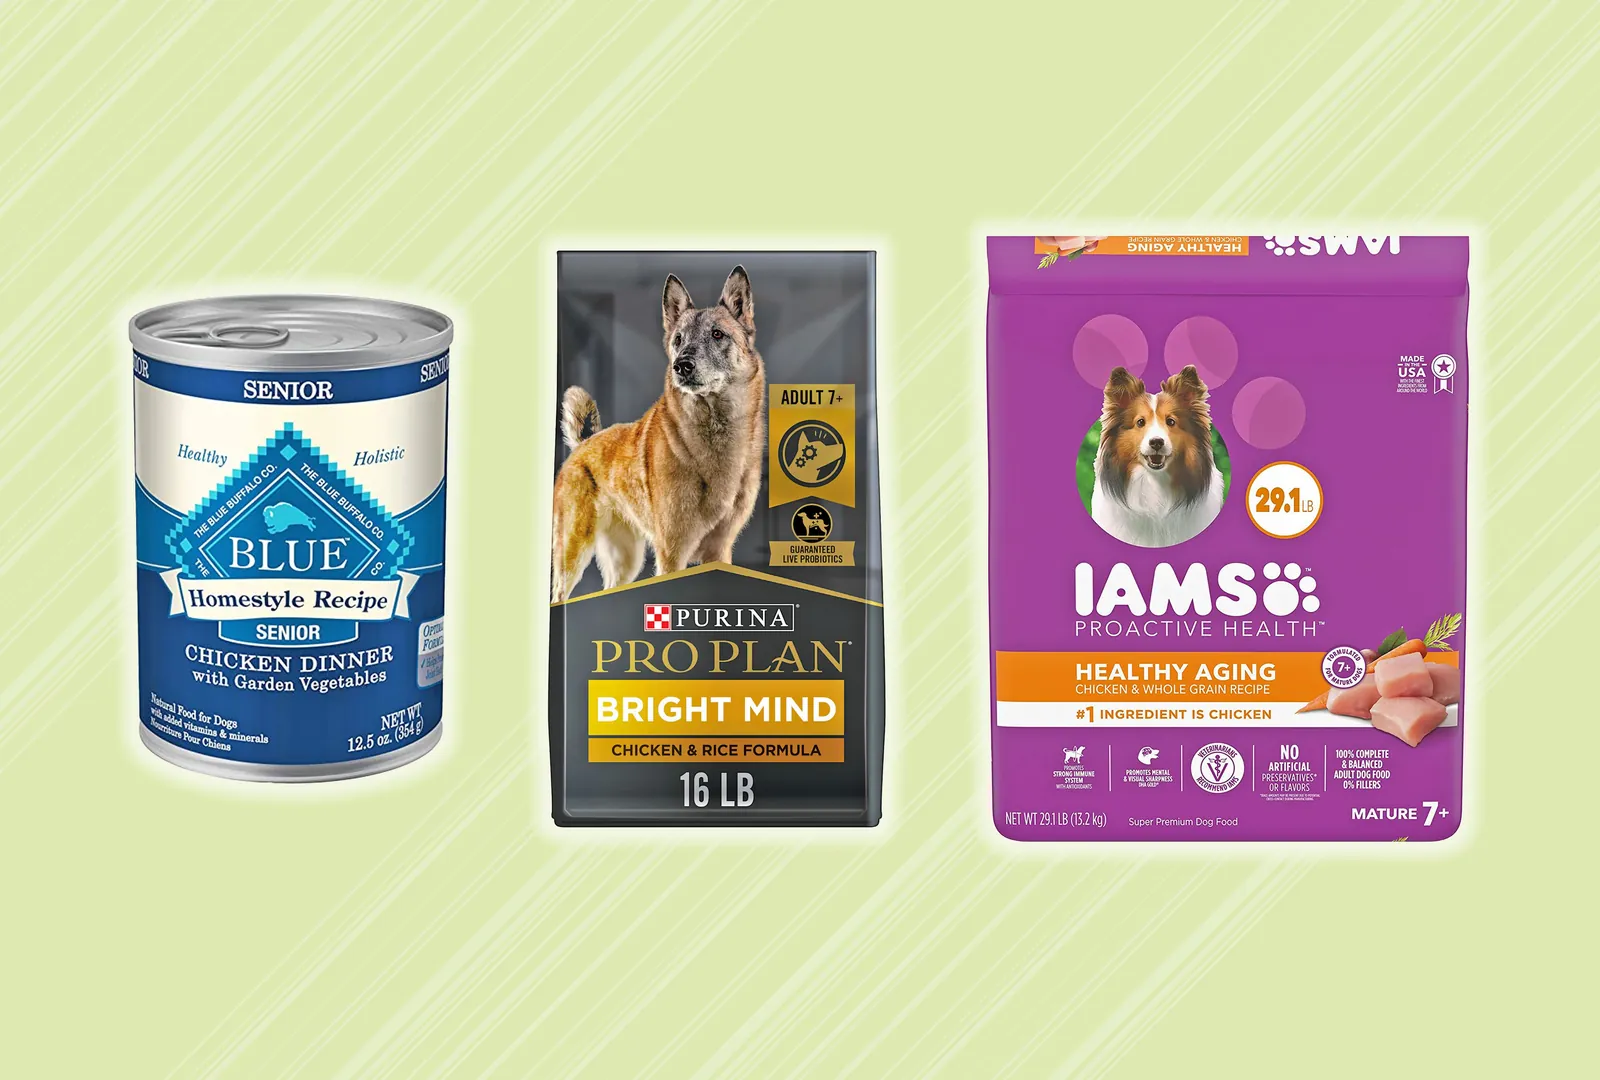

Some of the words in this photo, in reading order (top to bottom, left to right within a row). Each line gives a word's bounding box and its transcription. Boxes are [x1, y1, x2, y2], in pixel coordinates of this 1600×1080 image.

[1127, 243, 1174, 252] AGING
[1178, 243, 1241, 252] HEALTHY
[1299, 236, 1400, 256] IAMS
[421, 354, 449, 383] SENIO
[1398, 367, 1426, 377] USA
[243, 379, 334, 400] SENIOR
[781, 389, 824, 405] ADULT
[828, 389, 843, 405] 7+
[177, 444, 228, 467] Healthy
[353, 446, 405, 467] Holistic
[193, 522, 210, 538] THE
[207, 506, 229, 527] BLUE
[226, 476, 262, 509] BUFFALO
[261, 464, 278, 478] CO.
[300, 463, 319, 481] THE
[316, 478, 340, 500] BLUE
[337, 497, 373, 529] BUFFALO
[371, 527, 384, 541] CO.
[1255, 487, 1300, 514] 29.1
[1302, 500, 1313, 513] LB
[229, 536, 348, 571] BLUE
[790, 545, 836, 554] GUARANTEED
[194, 558, 211, 577] THE
[783, 555, 798, 563] LIVE
[800, 555, 843, 563] PROBIOTICS
[370, 561, 386, 576] CO.
[1075, 562, 1257, 616] IAMS
[188, 589, 305, 612] Homestyle
[313, 590, 388, 613] Recipe
[675, 608, 789, 627] PURINA
[255, 623, 320, 641] SENIOR
[1075, 621, 1212, 636] PROACTIVE
[1224, 621, 1316, 636] HEALTH
[185, 644, 290, 673] CHICKEN
[300, 645, 394, 673] DINNER
[591, 639, 699, 673] PRO
[708, 640, 847, 673] PLAN
[1327, 649, 1361, 661] FORMULATED
[1076, 663, 1187, 681] HEALTHY
[1195, 663, 1276, 681] AGING
[1337, 662, 1351, 672] 7+
[192, 669, 229, 687] with
[234, 675, 295, 692] Garden
[300, 670, 387, 694] Vegetables
[1075, 684, 1128, 695] CHICKEN
[1131, 684, 1140, 695] &
[1142, 684, 1187, 695] WHOLE
[1189, 684, 1228, 695] GRAIN
[1230, 684, 1271, 695] RECIPE
[1331, 676, 1353, 685] MATURE
[150, 692, 176, 714] Natural
[177, 705, 197, 720] Food
[198, 711, 212, 724] for
[213, 714, 238, 730] Dogs
[381, 709, 405, 730] NET
[407, 702, 422, 721] WT
[597, 696, 732, 722] BRIGHT
[744, 696, 837, 722] MIND
[1075, 706, 1095, 723] #1
[1100, 709, 1188, 720] INGREDIENT
[1191, 709, 1204, 720] IS
[1207, 709, 1272, 720] CHICKEN
[150, 707, 163, 720] with
[163, 713, 183, 728] added
[183, 721, 218, 737] vitamins
[219, 729, 228, 739] &
[229, 732, 269, 744] minerals
[150, 716, 183, 739] Nourriture
[183, 731, 201, 745] Pour
[202, 737, 232, 752] Chiens
[347, 734, 374, 752] 12.5
[377, 734, 393, 746] oz.
[394, 721, 414, 743] (354
[416, 716, 424, 736] g)
[611, 744, 682, 757] CHICKEN
[687, 744, 697, 757] &
[703, 744, 738, 757] RICE
[743, 744, 822, 757] FORMULA
[1198, 745, 1237, 758] VETERINARIANS
[1281, 745, 1299, 760] NO
[1336, 750, 1354, 759] 100%
[1356, 750, 1389, 759] COMPLETE
[1268, 762, 1310, 771] ARTIFICIAL
[1342, 760, 1347, 769] &
[1349, 760, 1383, 769] BALANCED
[1196, 776, 1227, 791] RECOMMEND
[1334, 770, 1355, 779] ADULT
[1356, 770, 1371, 779] DOG
[1372, 770, 1390, 779] FOOD
[680, 771, 709, 807] 16
[720, 771, 755, 807] LB
[1269, 783, 1279, 792] OR
[1280, 783, 1310, 792] FLAVORS
[1343, 780, 1354, 790] 0%
[1356, 780, 1381, 790] FILLERS
[1005, 812, 1022, 825] NET
[1023, 812, 1038, 825] WT
[1039, 812, 1057, 825] 29.1
[1058, 812, 1068, 825] LB
[1070, 811, 1090, 827] (13.2
[1092, 811, 1107, 828] kg)
[1128, 818, 1153, 828] Super
[1156, 818, 1194, 826] Premium
[1196, 818, 1214, 828] Dog
[1216, 818, 1238, 826] Food
[1352, 808, 1417, 820] MATURE
[1422, 802, 1449, 826] 7+
